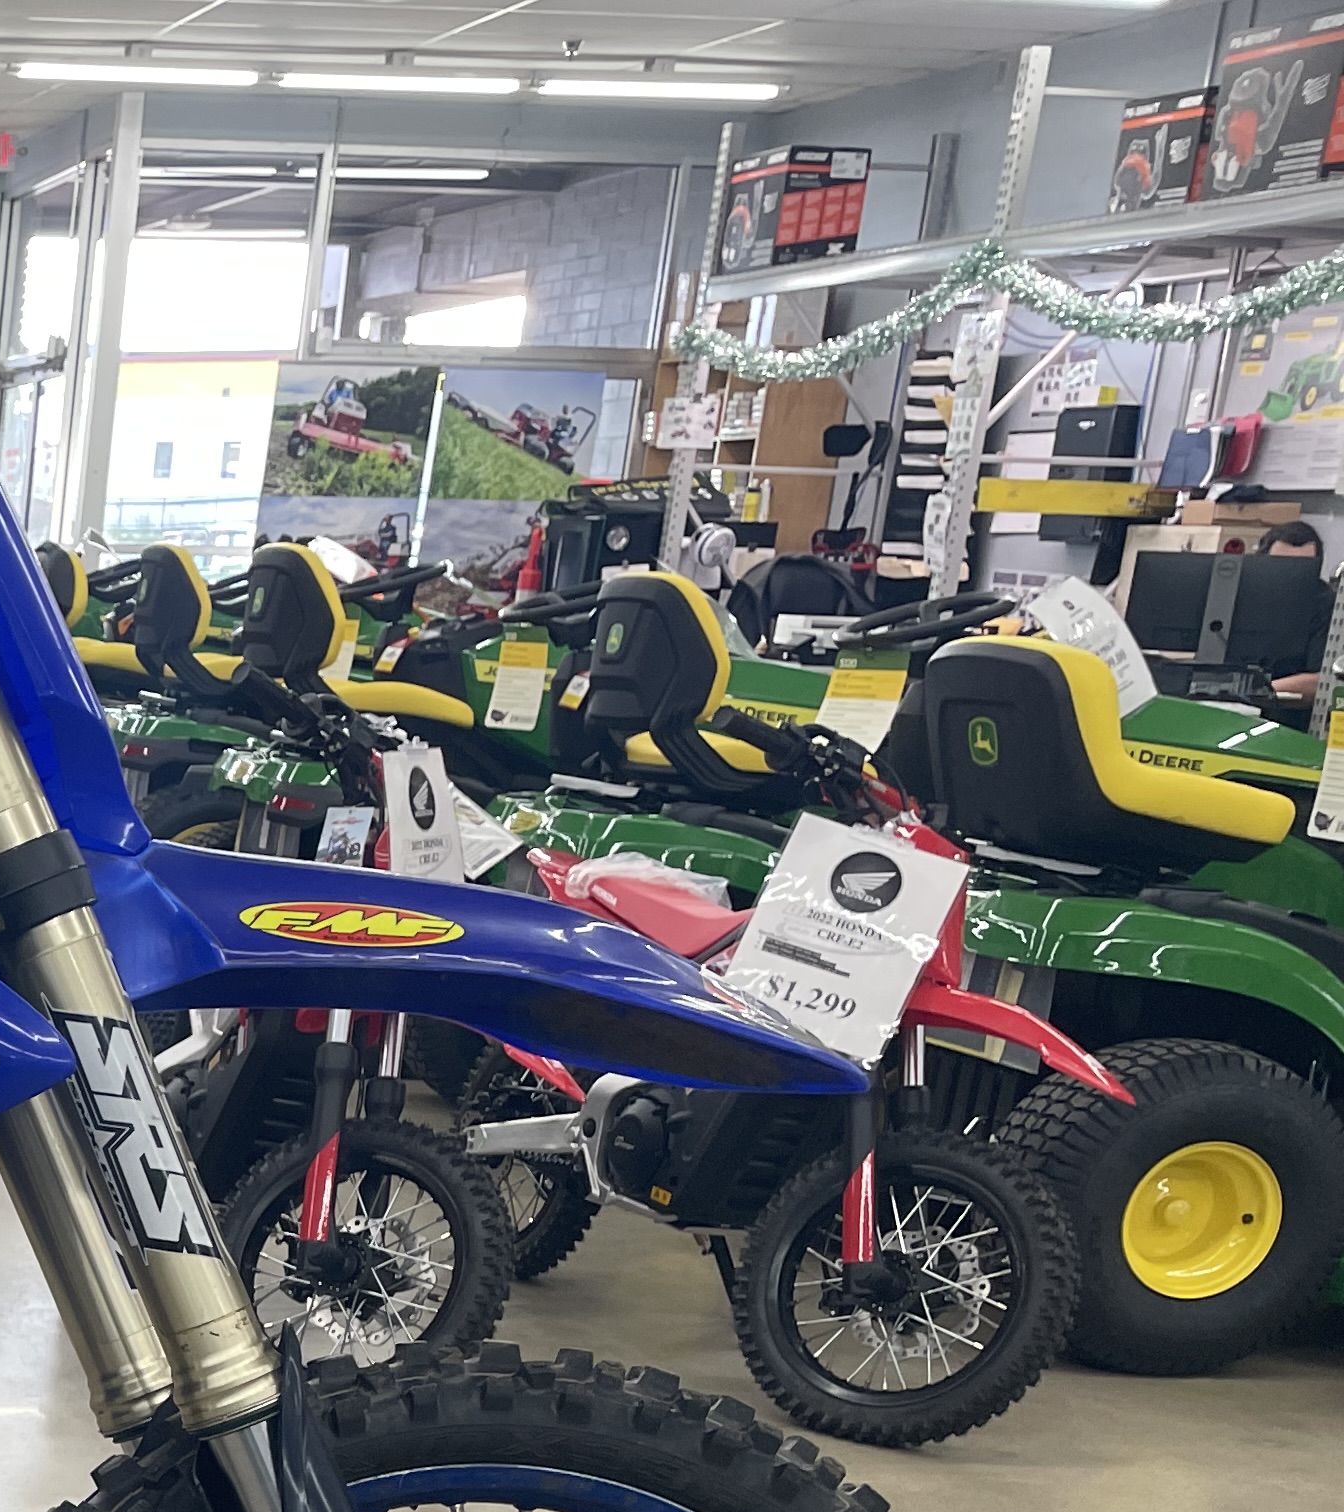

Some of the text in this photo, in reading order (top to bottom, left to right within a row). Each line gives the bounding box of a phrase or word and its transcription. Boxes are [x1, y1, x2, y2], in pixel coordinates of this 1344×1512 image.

[1138, 749, 1204, 772] DEERE
[835, 885, 883, 907] HONDA
[249, 904, 457, 938] FMF
[806, 908, 884, 942] 2022 HONDA
[763, 974, 857, 1020] $1,299
